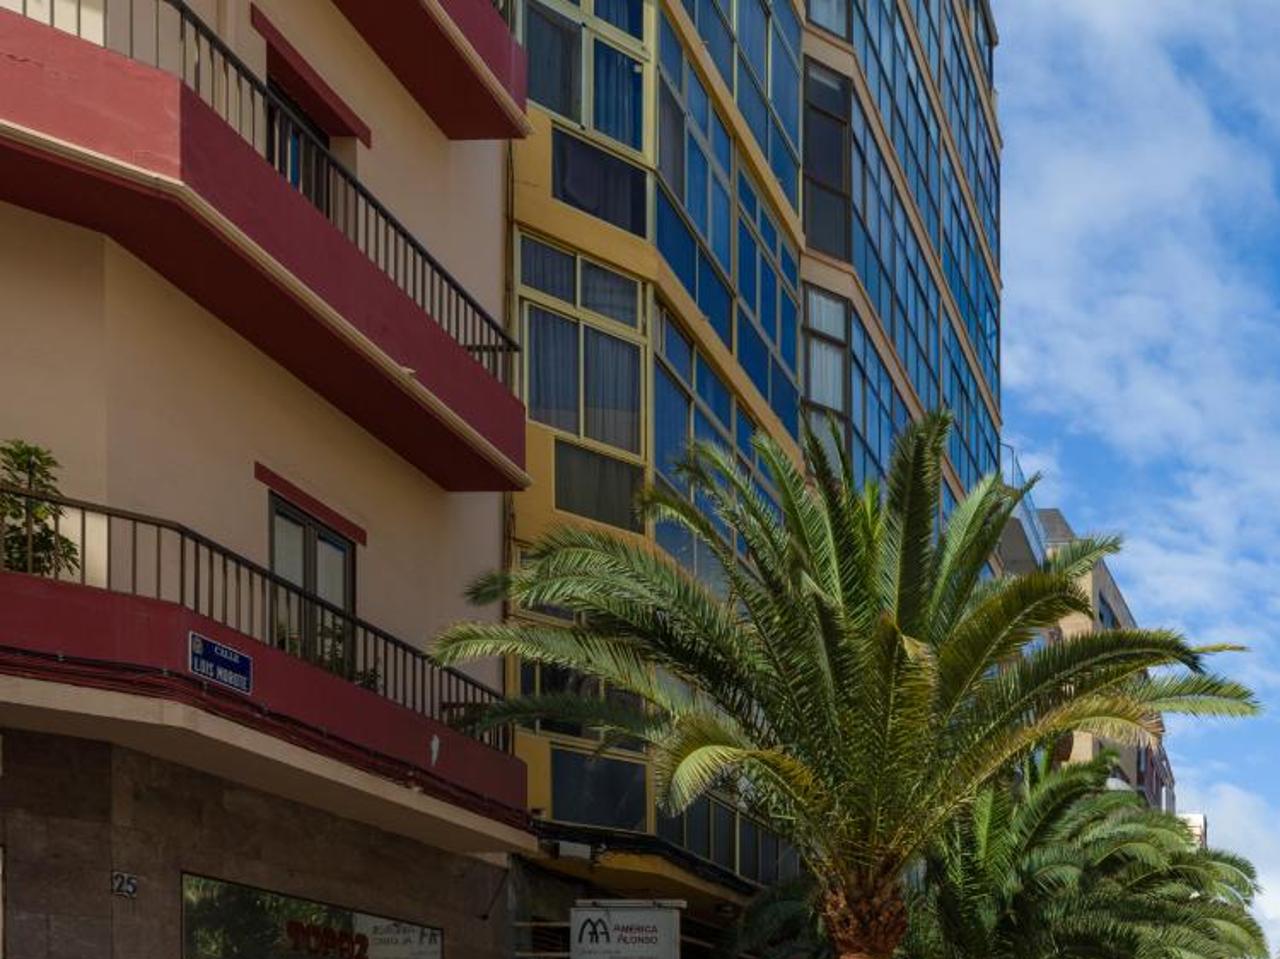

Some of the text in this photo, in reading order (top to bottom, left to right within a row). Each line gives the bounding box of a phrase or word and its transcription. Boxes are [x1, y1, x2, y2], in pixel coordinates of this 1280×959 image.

[193, 656, 214, 677] LUIS
[112, 873, 137, 895] 25
[617, 934, 658, 945] ALONSO
